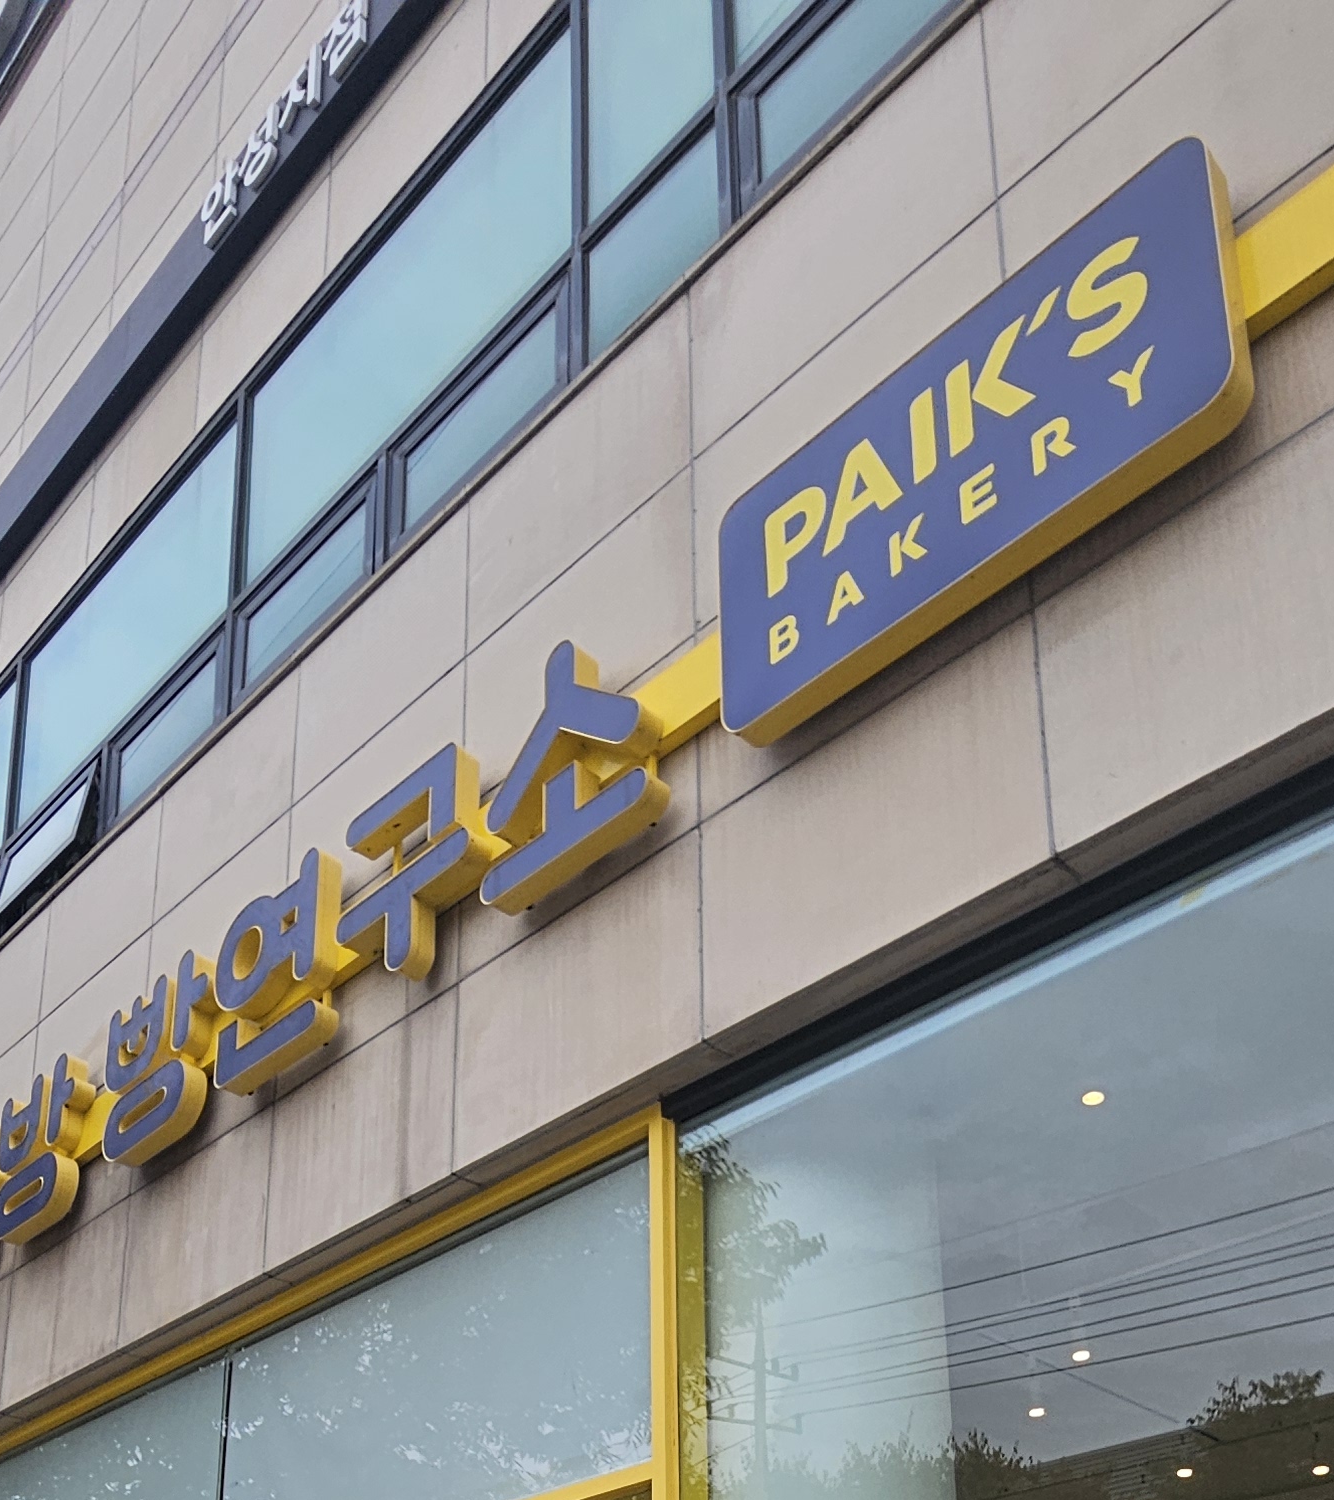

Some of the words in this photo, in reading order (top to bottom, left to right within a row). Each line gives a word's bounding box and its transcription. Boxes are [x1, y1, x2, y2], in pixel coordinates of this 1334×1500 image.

[200, 0, 368, 247] 안성지점
[763, 235, 1150, 600] PAIK'S
[768, 345, 1156, 666] BAKERY
